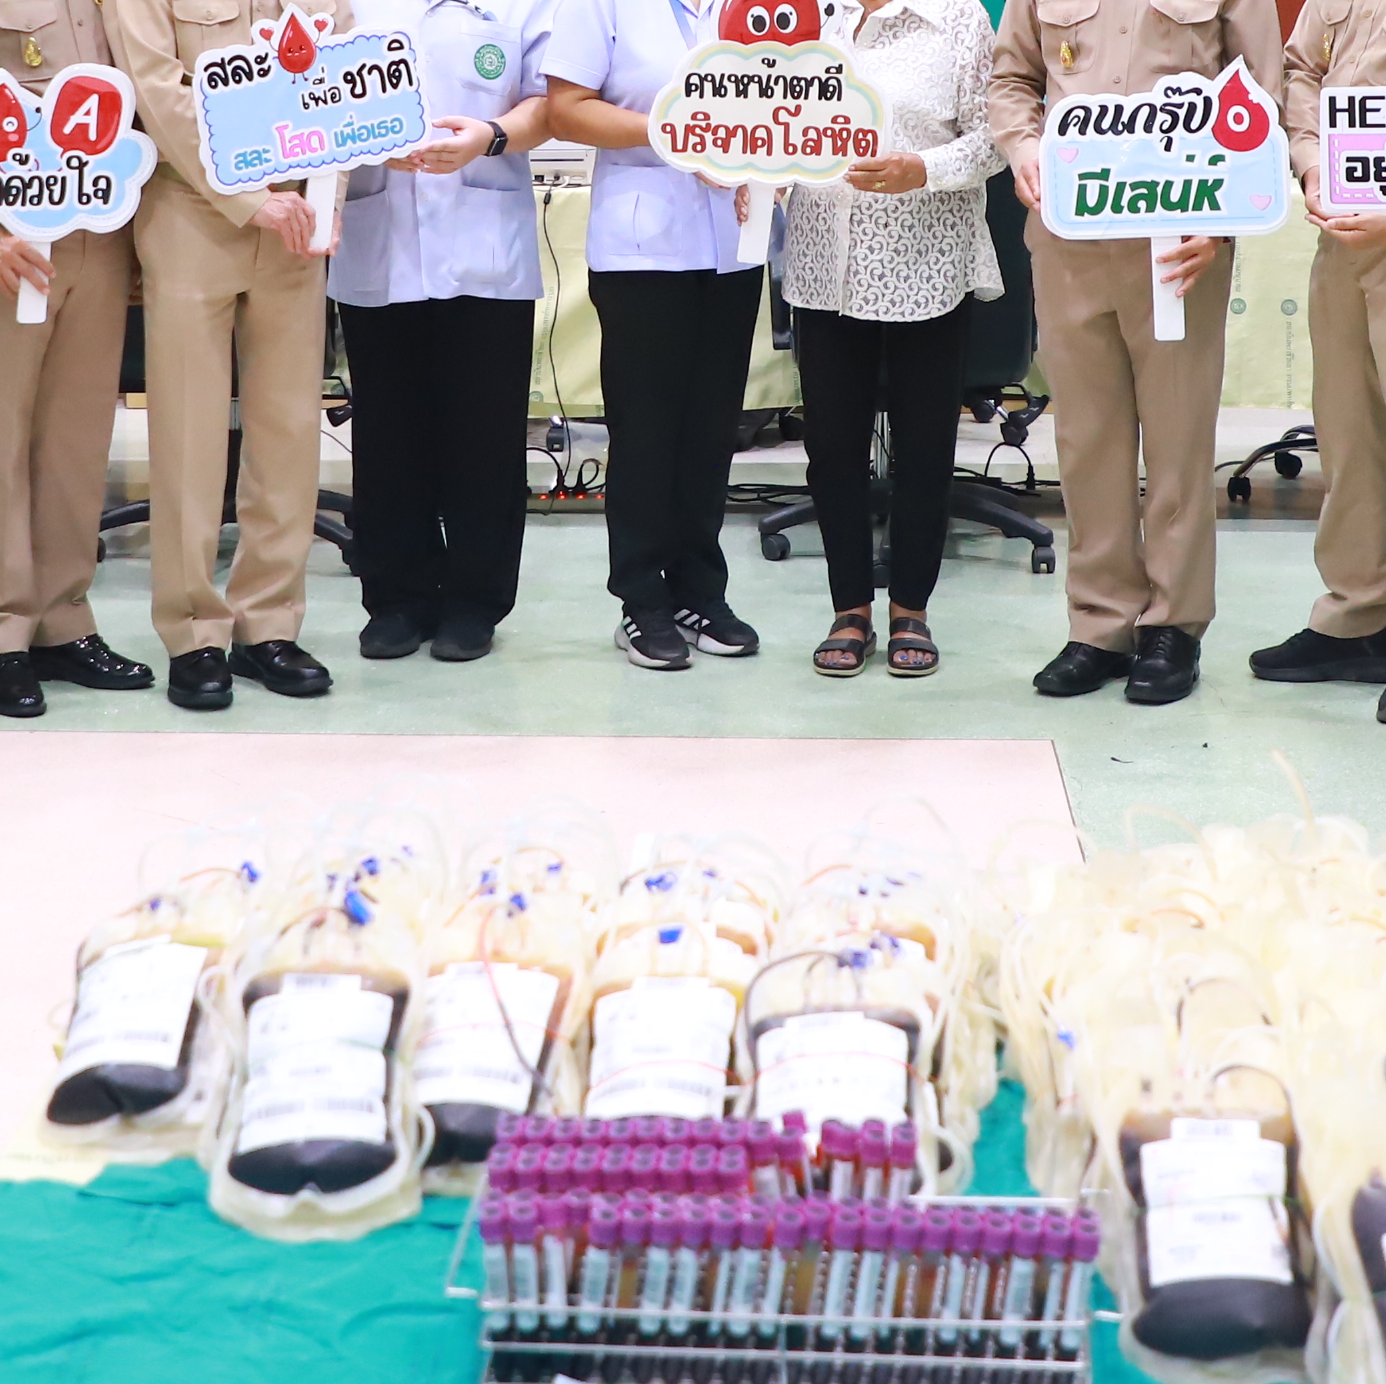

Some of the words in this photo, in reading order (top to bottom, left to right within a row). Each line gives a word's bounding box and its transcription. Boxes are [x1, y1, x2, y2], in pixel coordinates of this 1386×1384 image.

[204, 51, 272, 90] สละ
[301, 66, 342, 110] เพื่อ
[343, 38, 413, 99] ชาติ
[685, 57, 843, 101] คนหน้าตาดี
[63, 93, 100, 142] A
[234, 148, 273, 171] สละ
[275, 124, 325, 159] โสด
[334, 115, 405, 148] เพื่อเธอ
[661, 105, 879, 157] บริจาคโลหิต
[1058, 86, 1213, 152] คนกรุ๊ป
[1075, 154, 1226, 216] มีเสน่ห์
